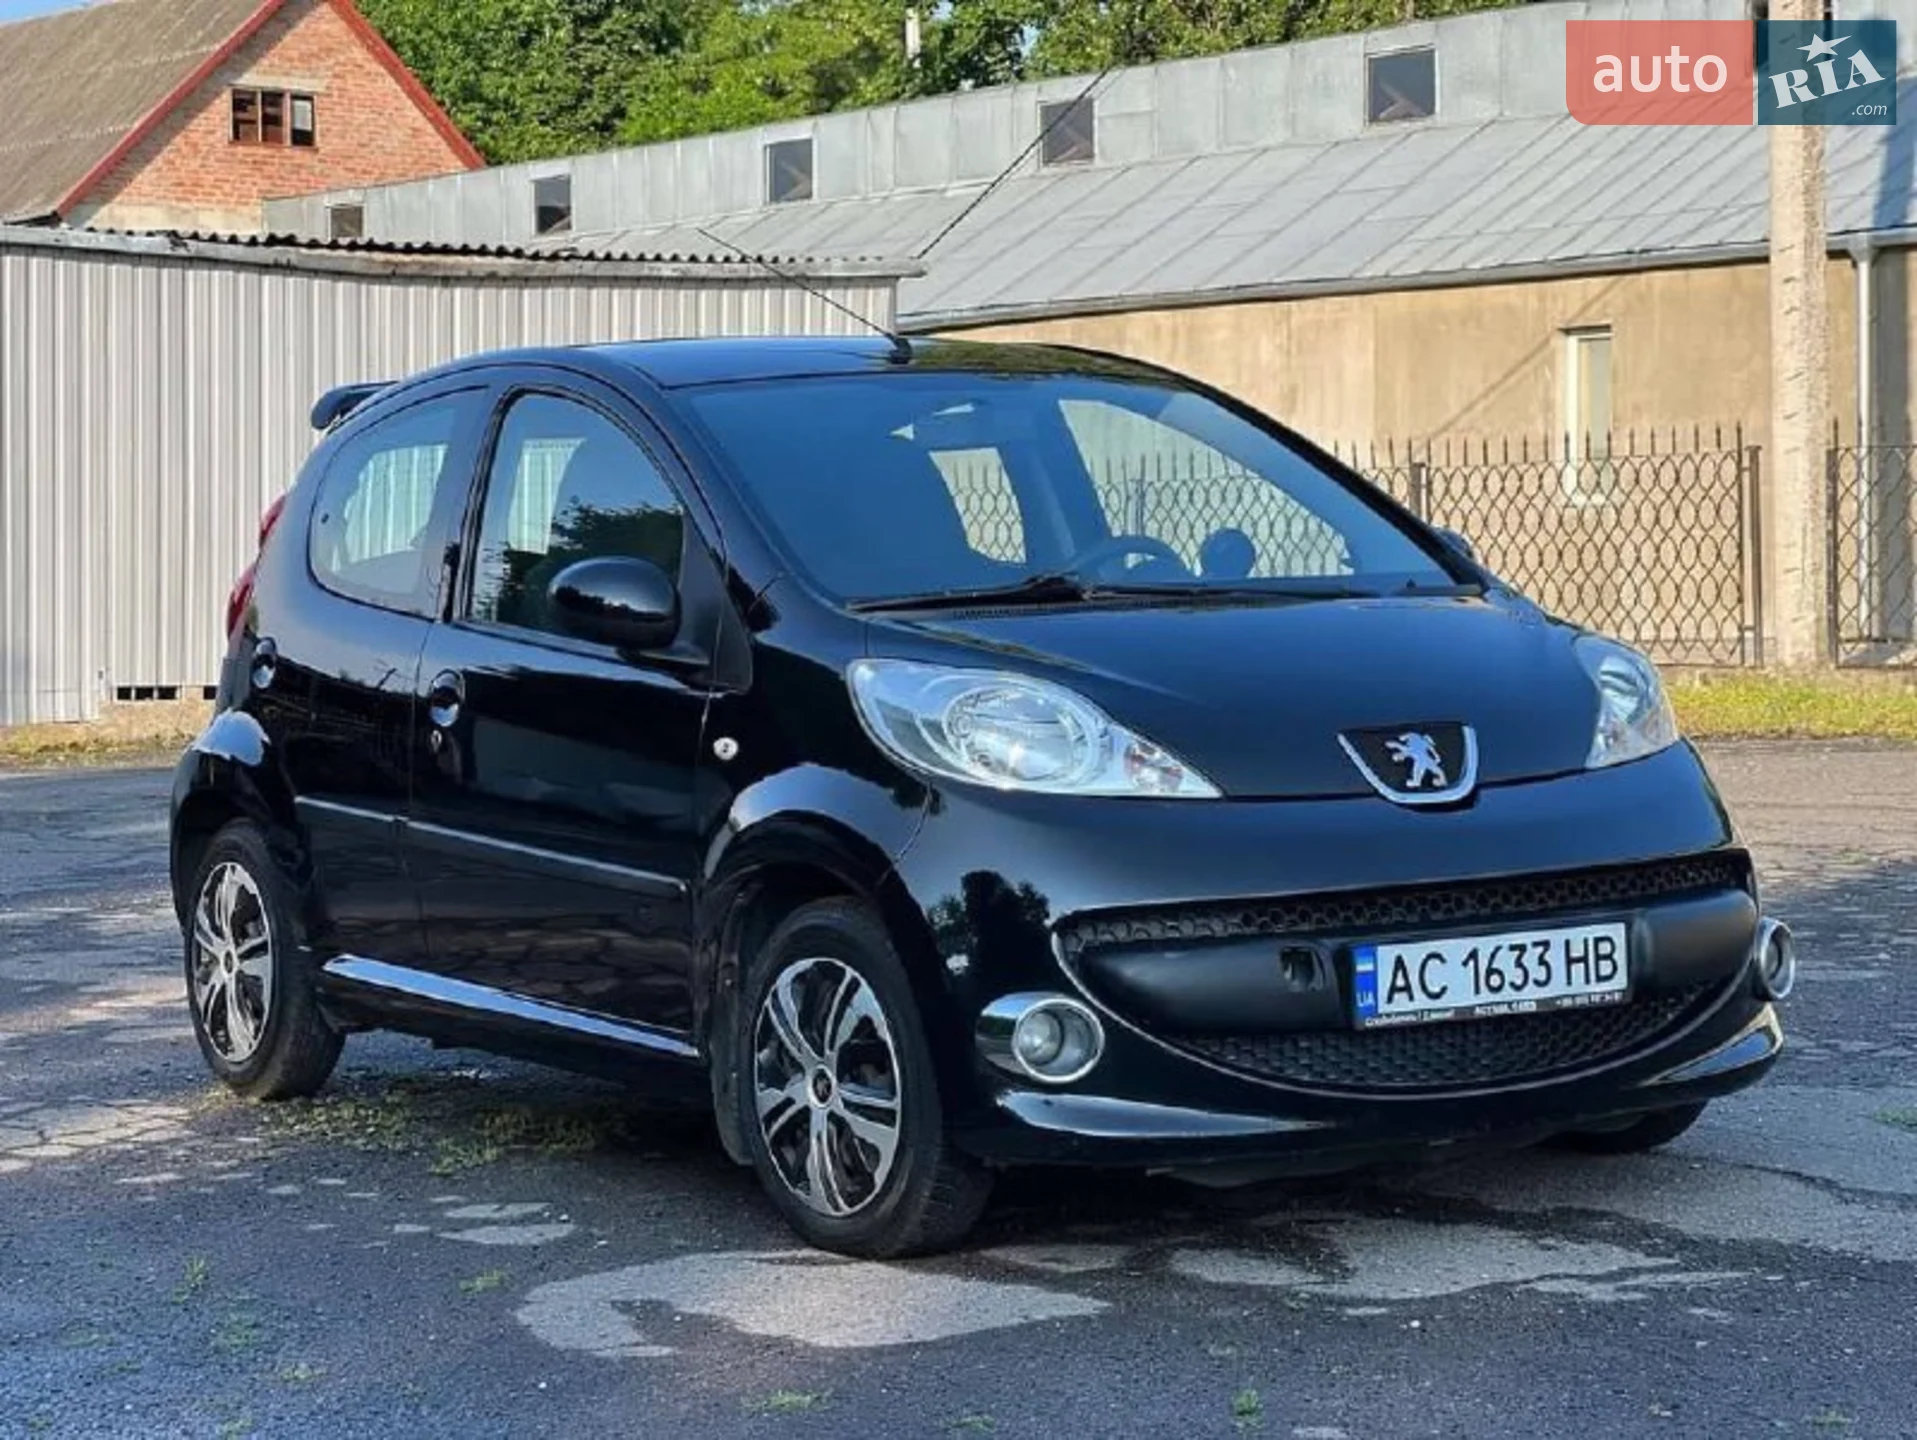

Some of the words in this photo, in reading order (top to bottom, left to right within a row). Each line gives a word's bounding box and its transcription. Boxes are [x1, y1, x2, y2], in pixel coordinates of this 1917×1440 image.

[1386, 952, 1448, 1004] AC
[1461, 939, 1551, 995] 1633
[1564, 935, 1618, 987] HB
[1356, 991, 1376, 1007] UA
